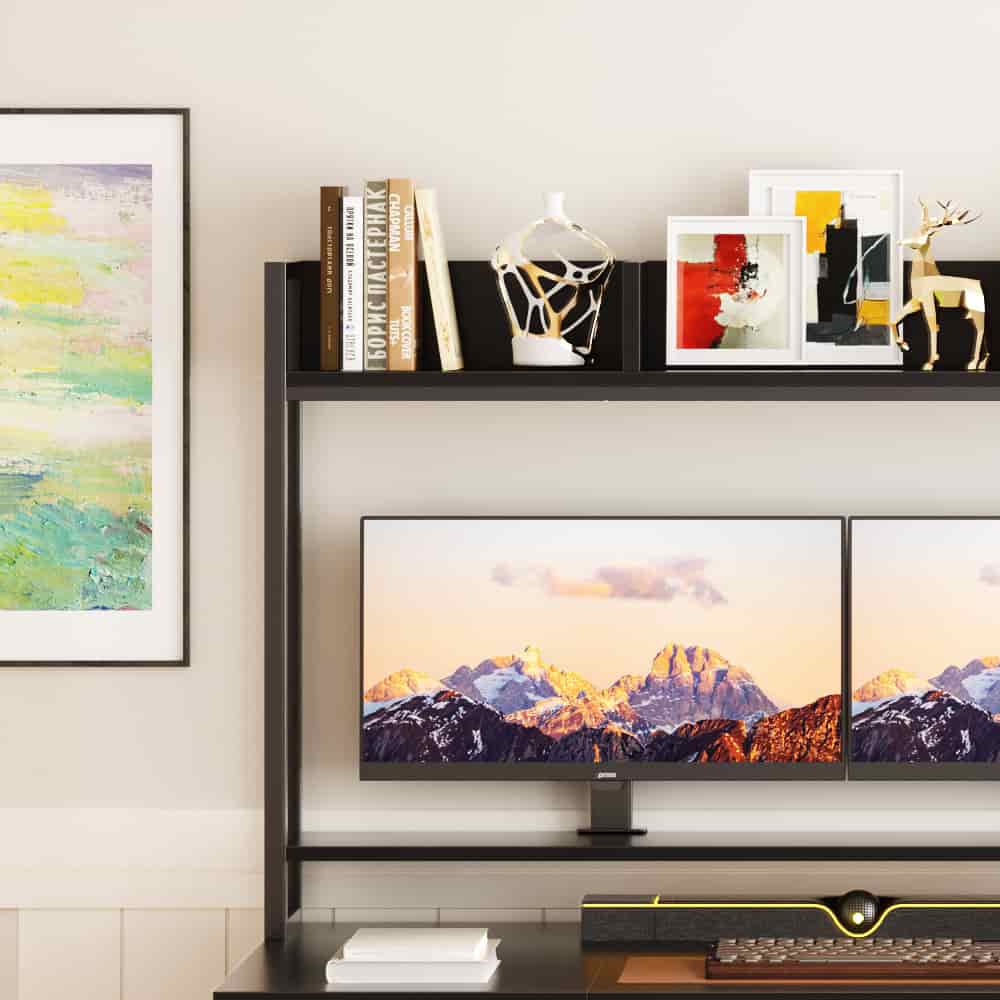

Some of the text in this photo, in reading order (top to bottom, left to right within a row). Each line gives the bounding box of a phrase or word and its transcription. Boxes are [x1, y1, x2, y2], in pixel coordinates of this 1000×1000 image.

[368, 188, 387, 359] БОРИС ПАСТЕРНАК
[389, 193, 401, 252] CHAPMAN
